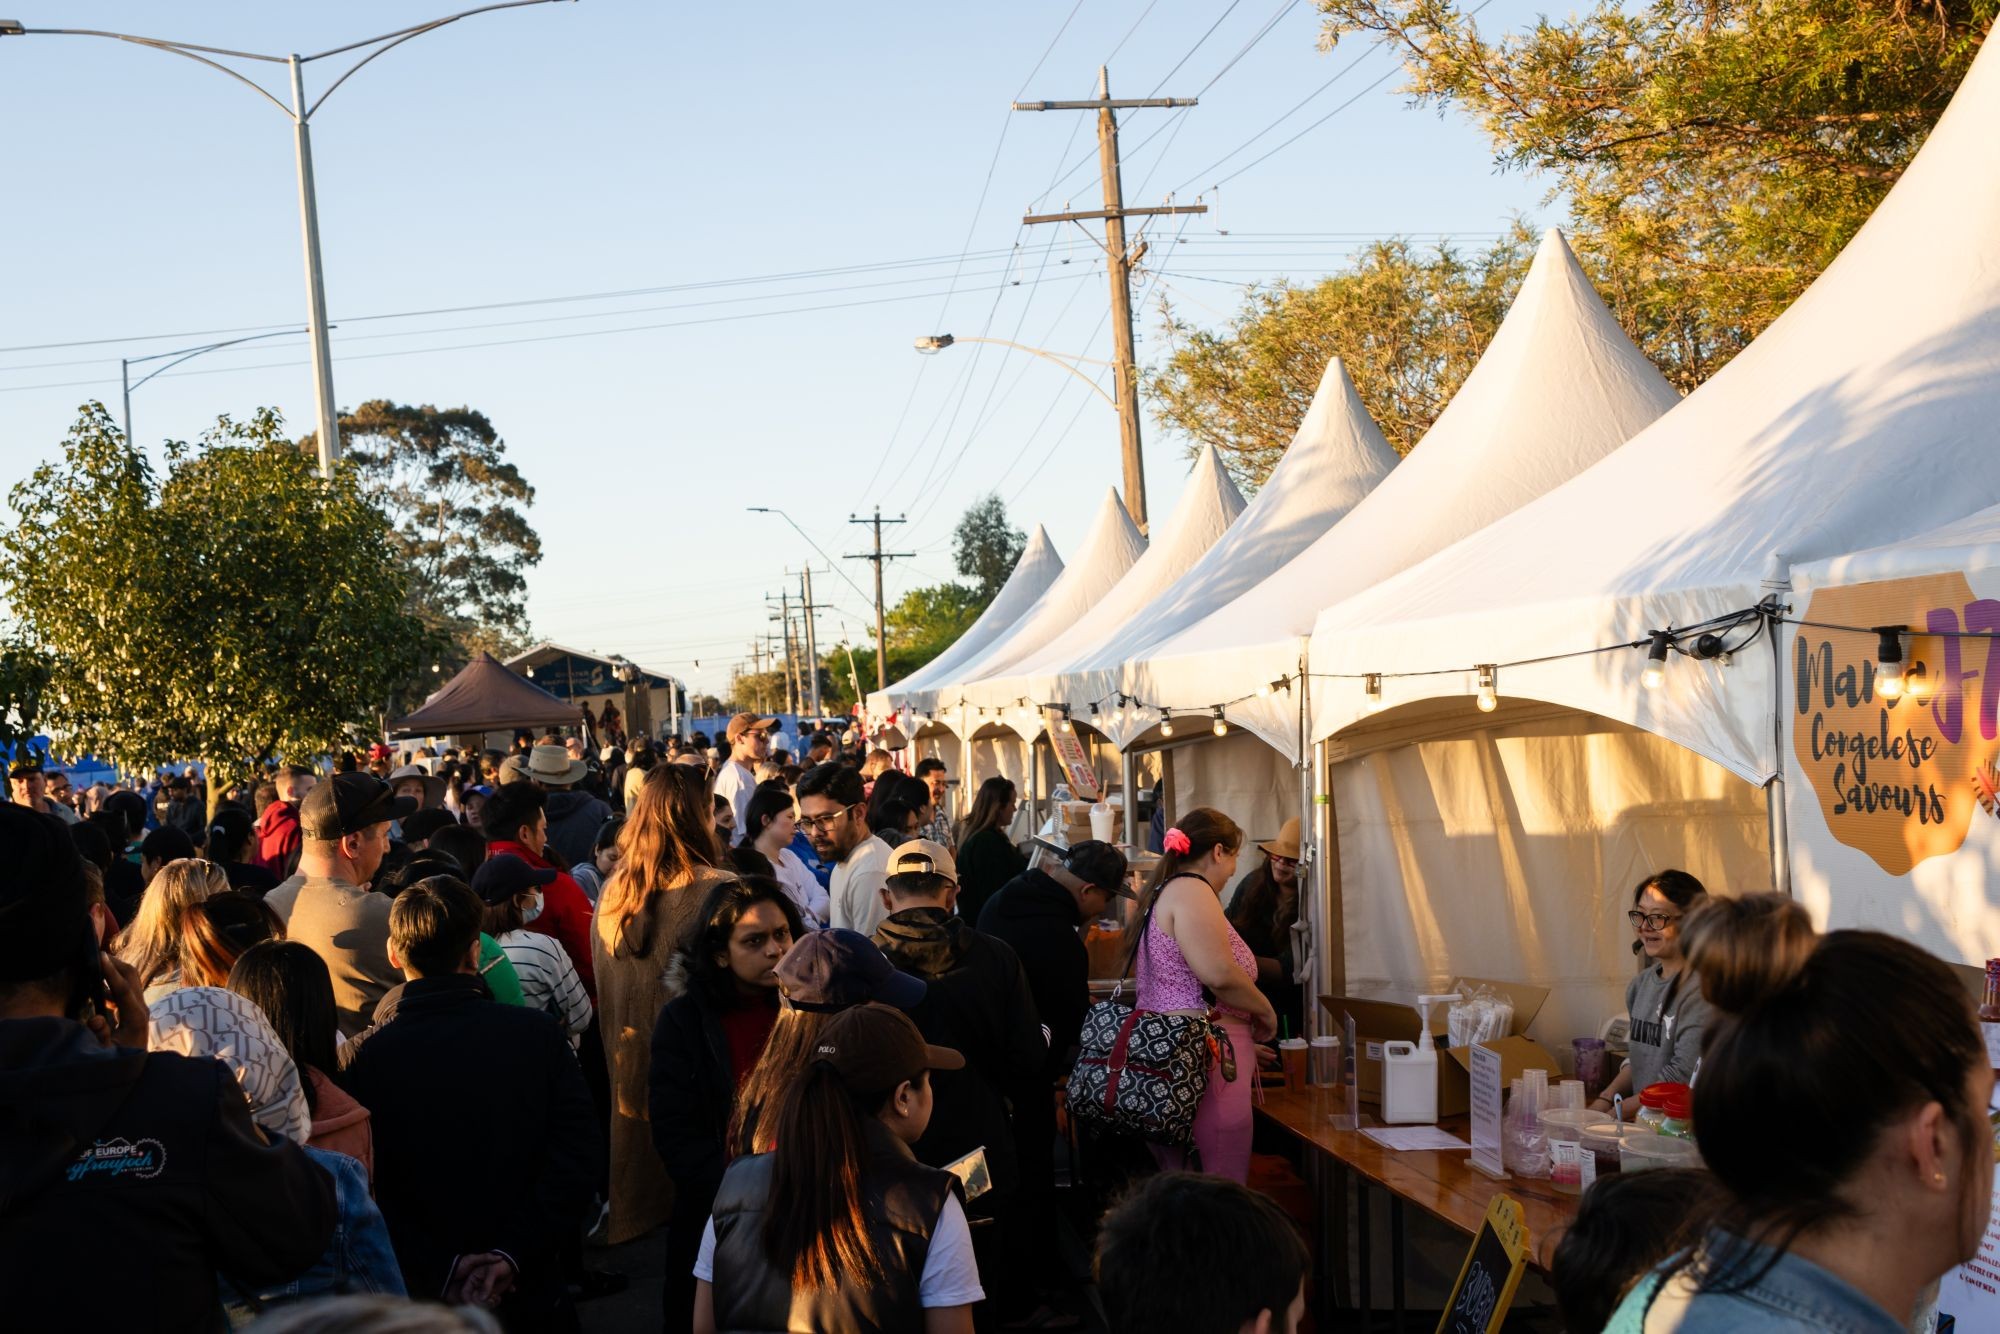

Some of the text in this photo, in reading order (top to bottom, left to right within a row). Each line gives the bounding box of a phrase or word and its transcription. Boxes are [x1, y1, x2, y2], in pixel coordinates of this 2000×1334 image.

[1833, 762, 1947, 825] Savours
[817, 1045, 836, 1054] POLO
[95, 1144, 137, 1157] EUROPE
